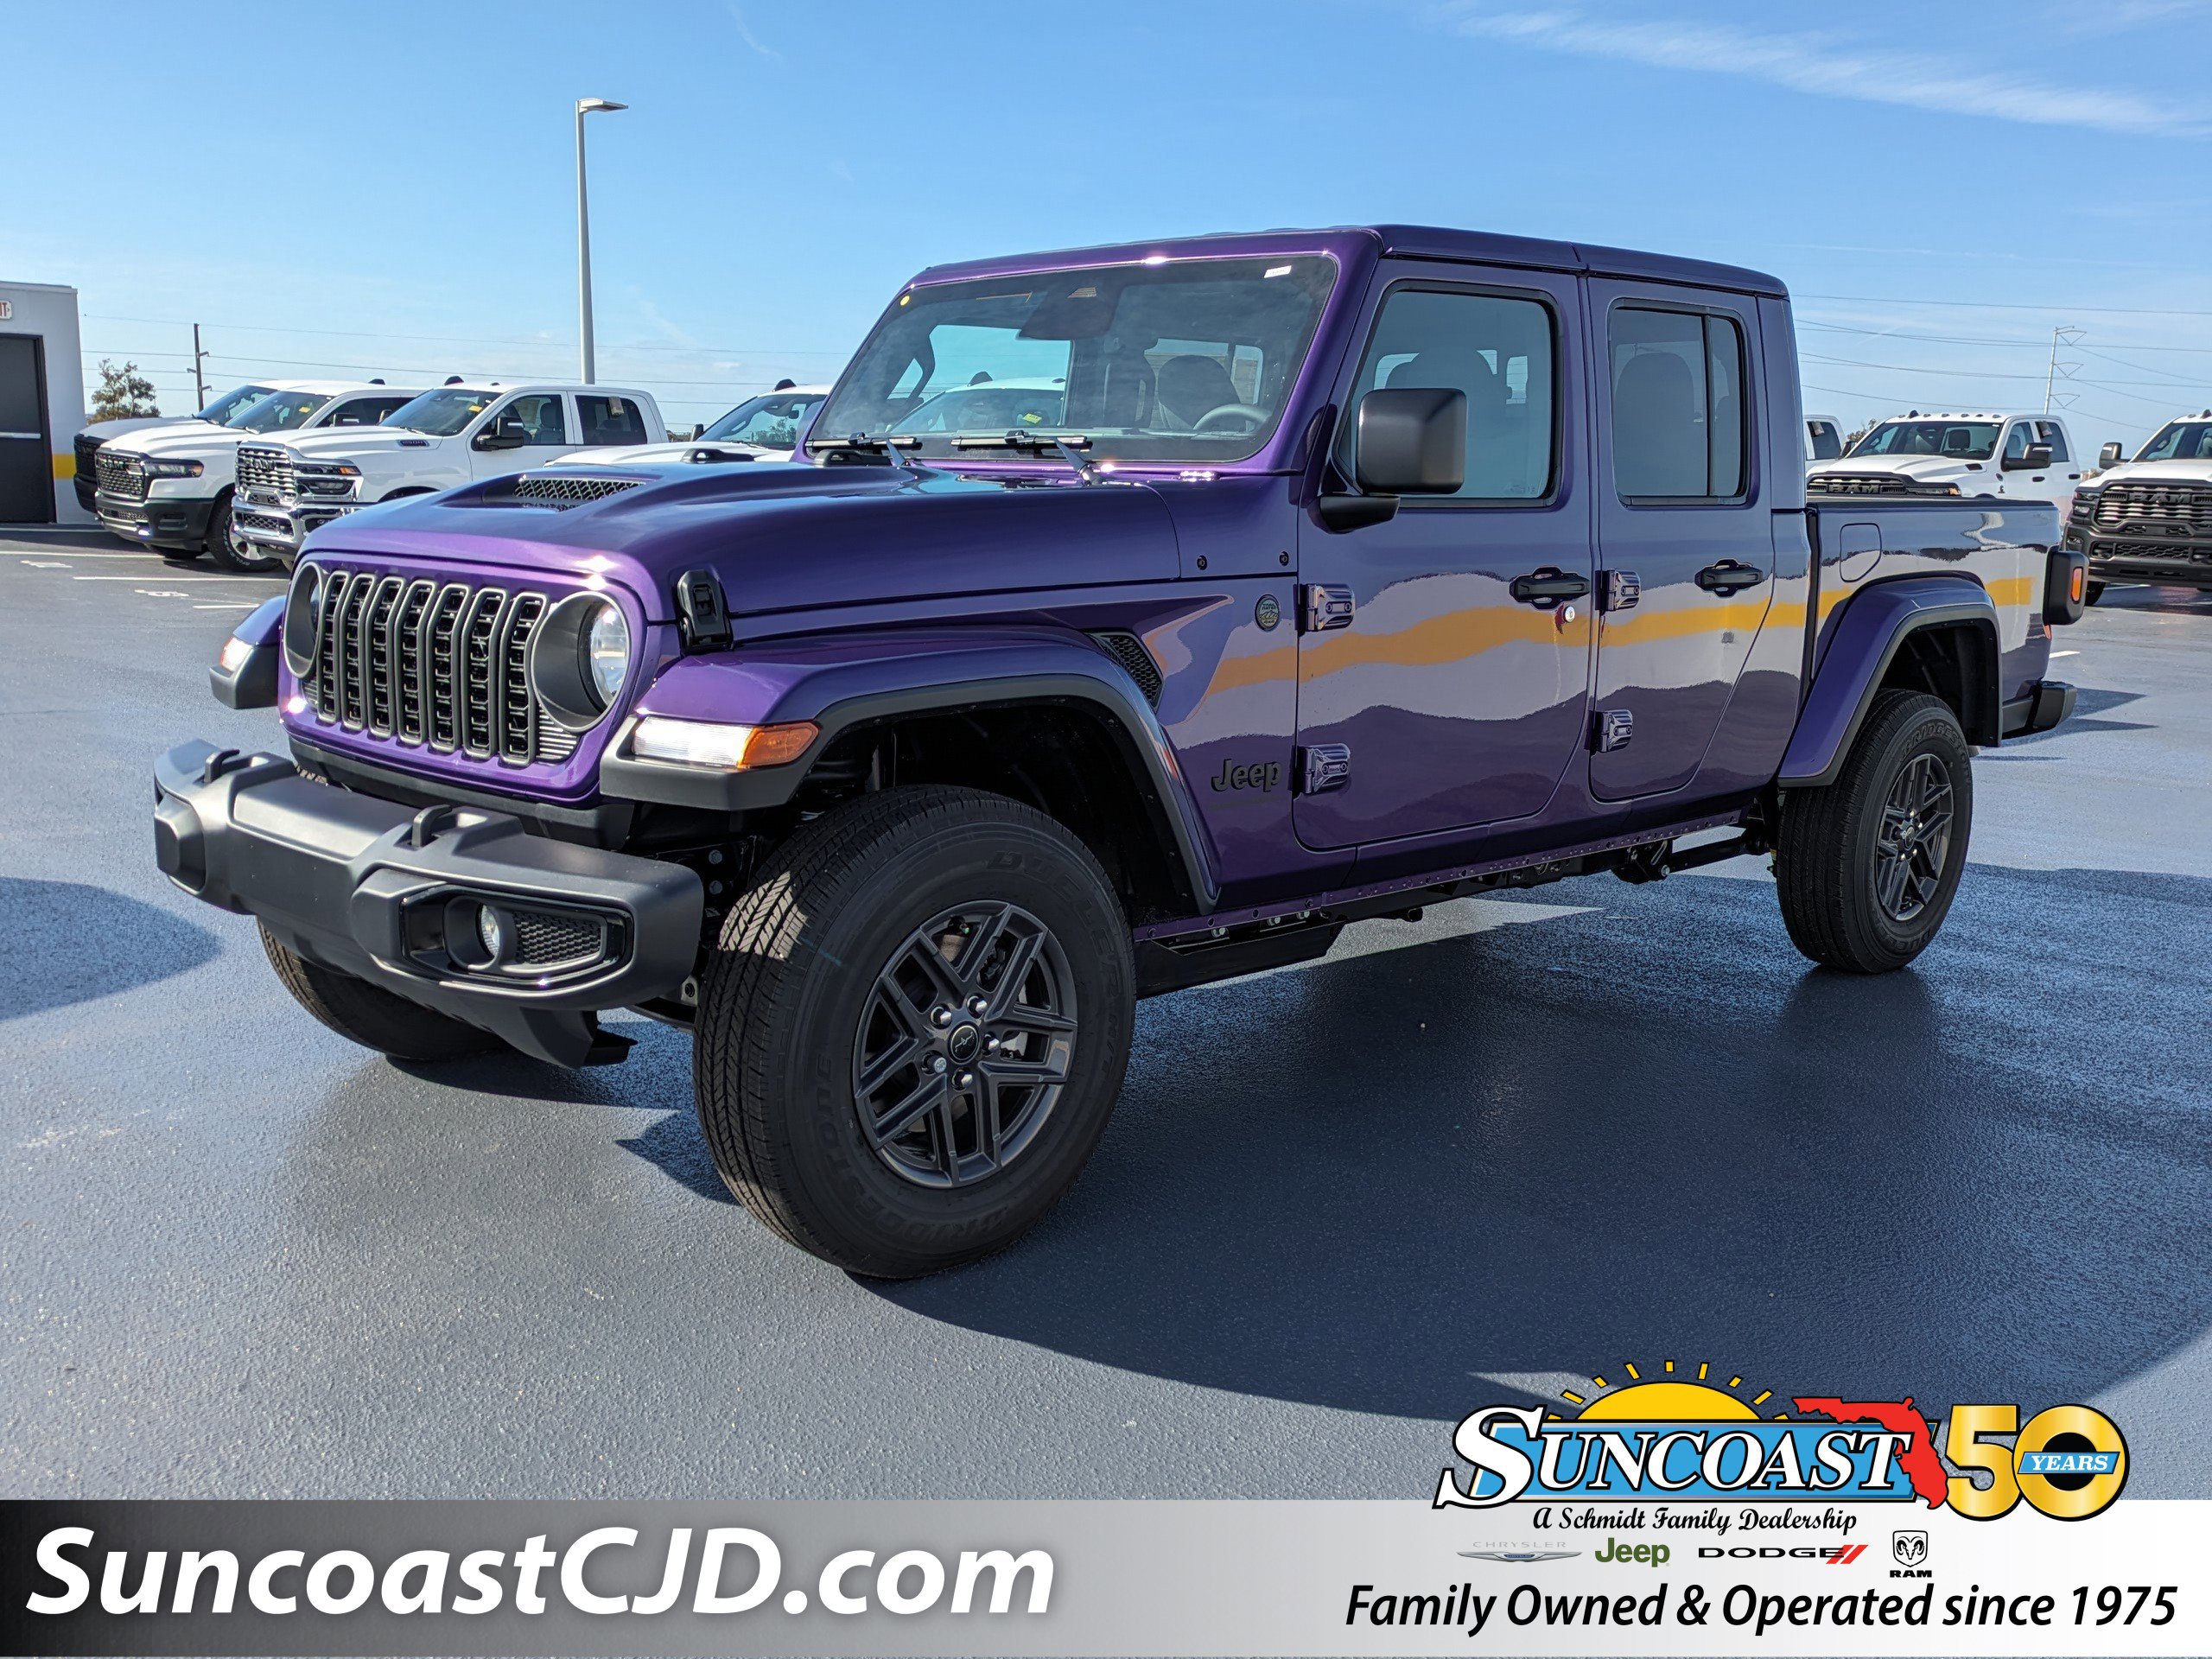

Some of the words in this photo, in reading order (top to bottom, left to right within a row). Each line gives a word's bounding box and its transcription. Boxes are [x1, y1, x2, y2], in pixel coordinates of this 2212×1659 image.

[1828, 483, 1880, 494] RAM
[2128, 491, 2192, 503] RAM
[1211, 759, 1282, 792] Jeep
